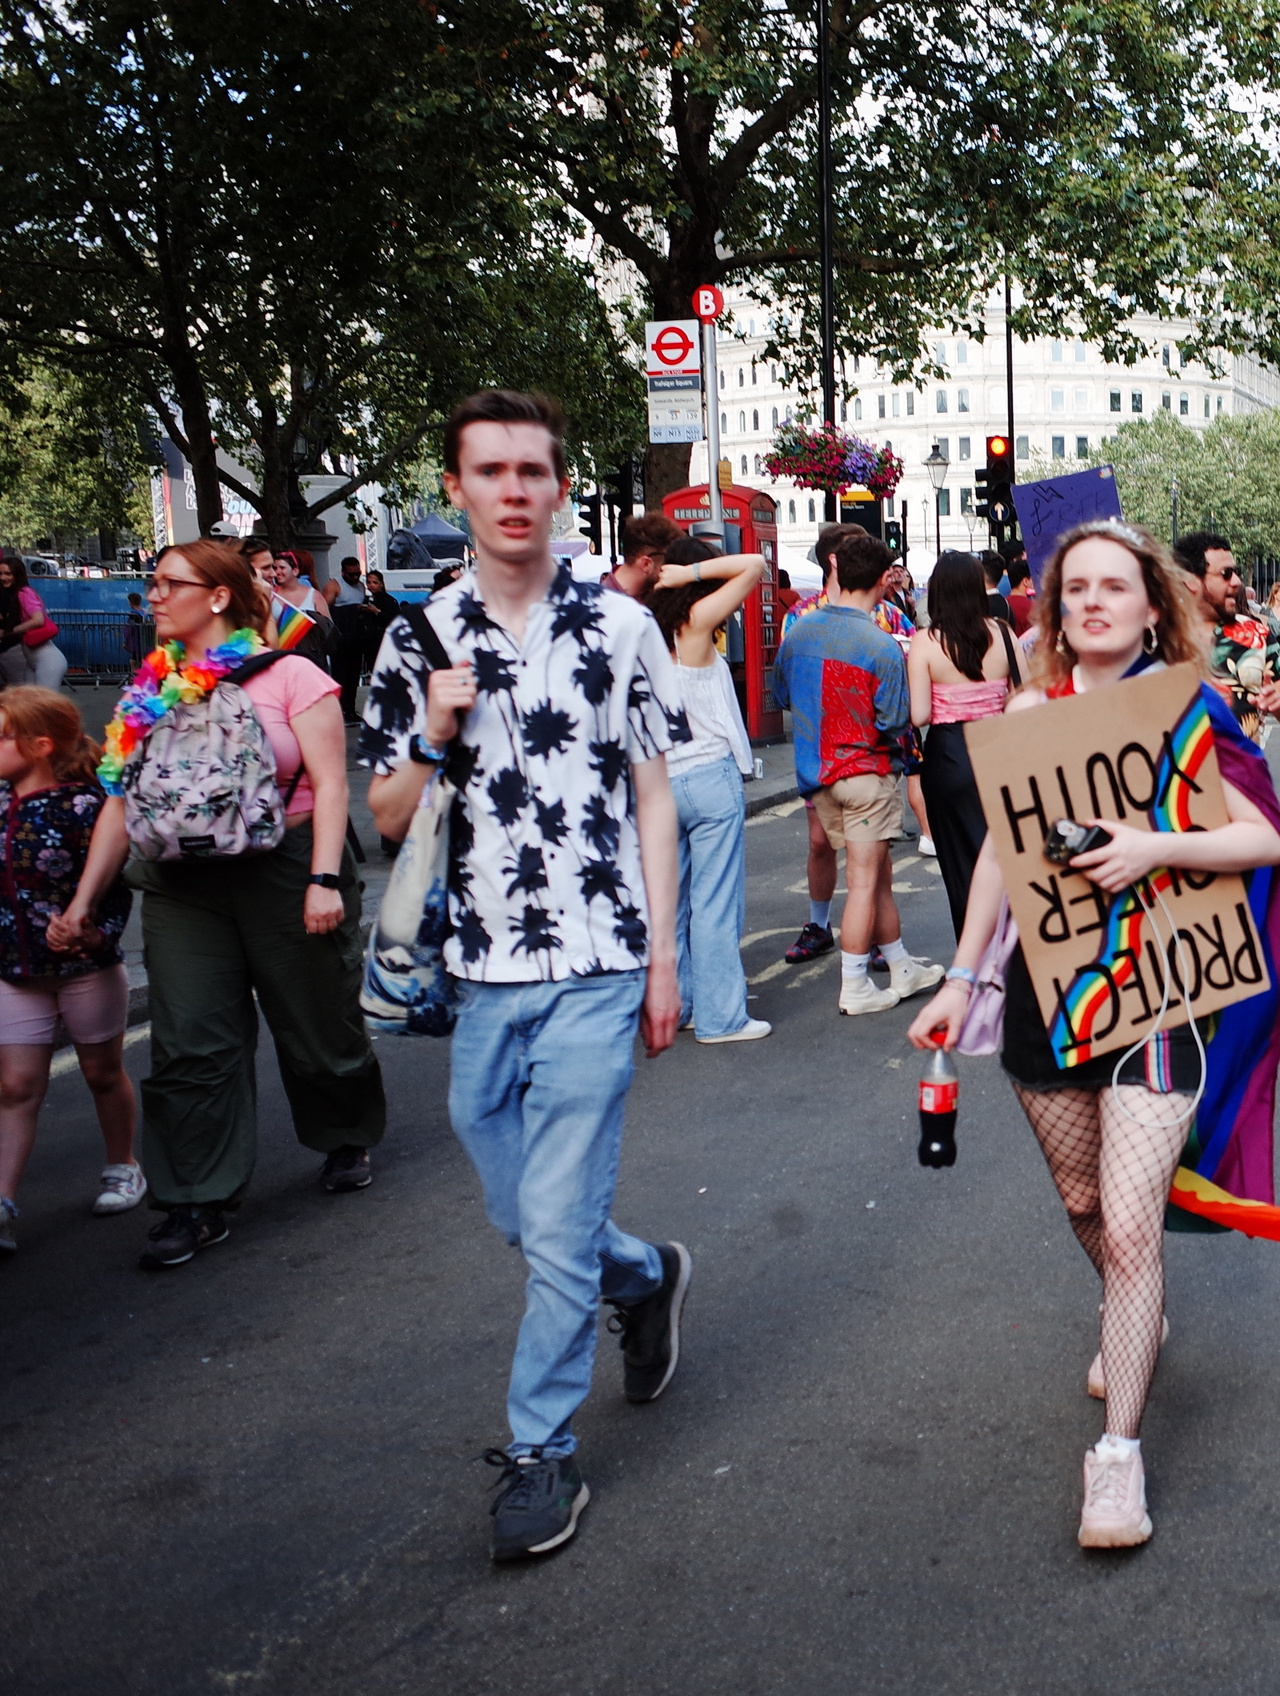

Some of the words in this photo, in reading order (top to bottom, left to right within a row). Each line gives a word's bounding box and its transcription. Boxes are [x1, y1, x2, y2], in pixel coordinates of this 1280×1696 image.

[699, 290, 716, 315] B
[675, 508, 740, 520] TELEPNE
[1000, 731, 1203, 854] YOUTH
[1052, 902, 1264, 1055] PROTECT
